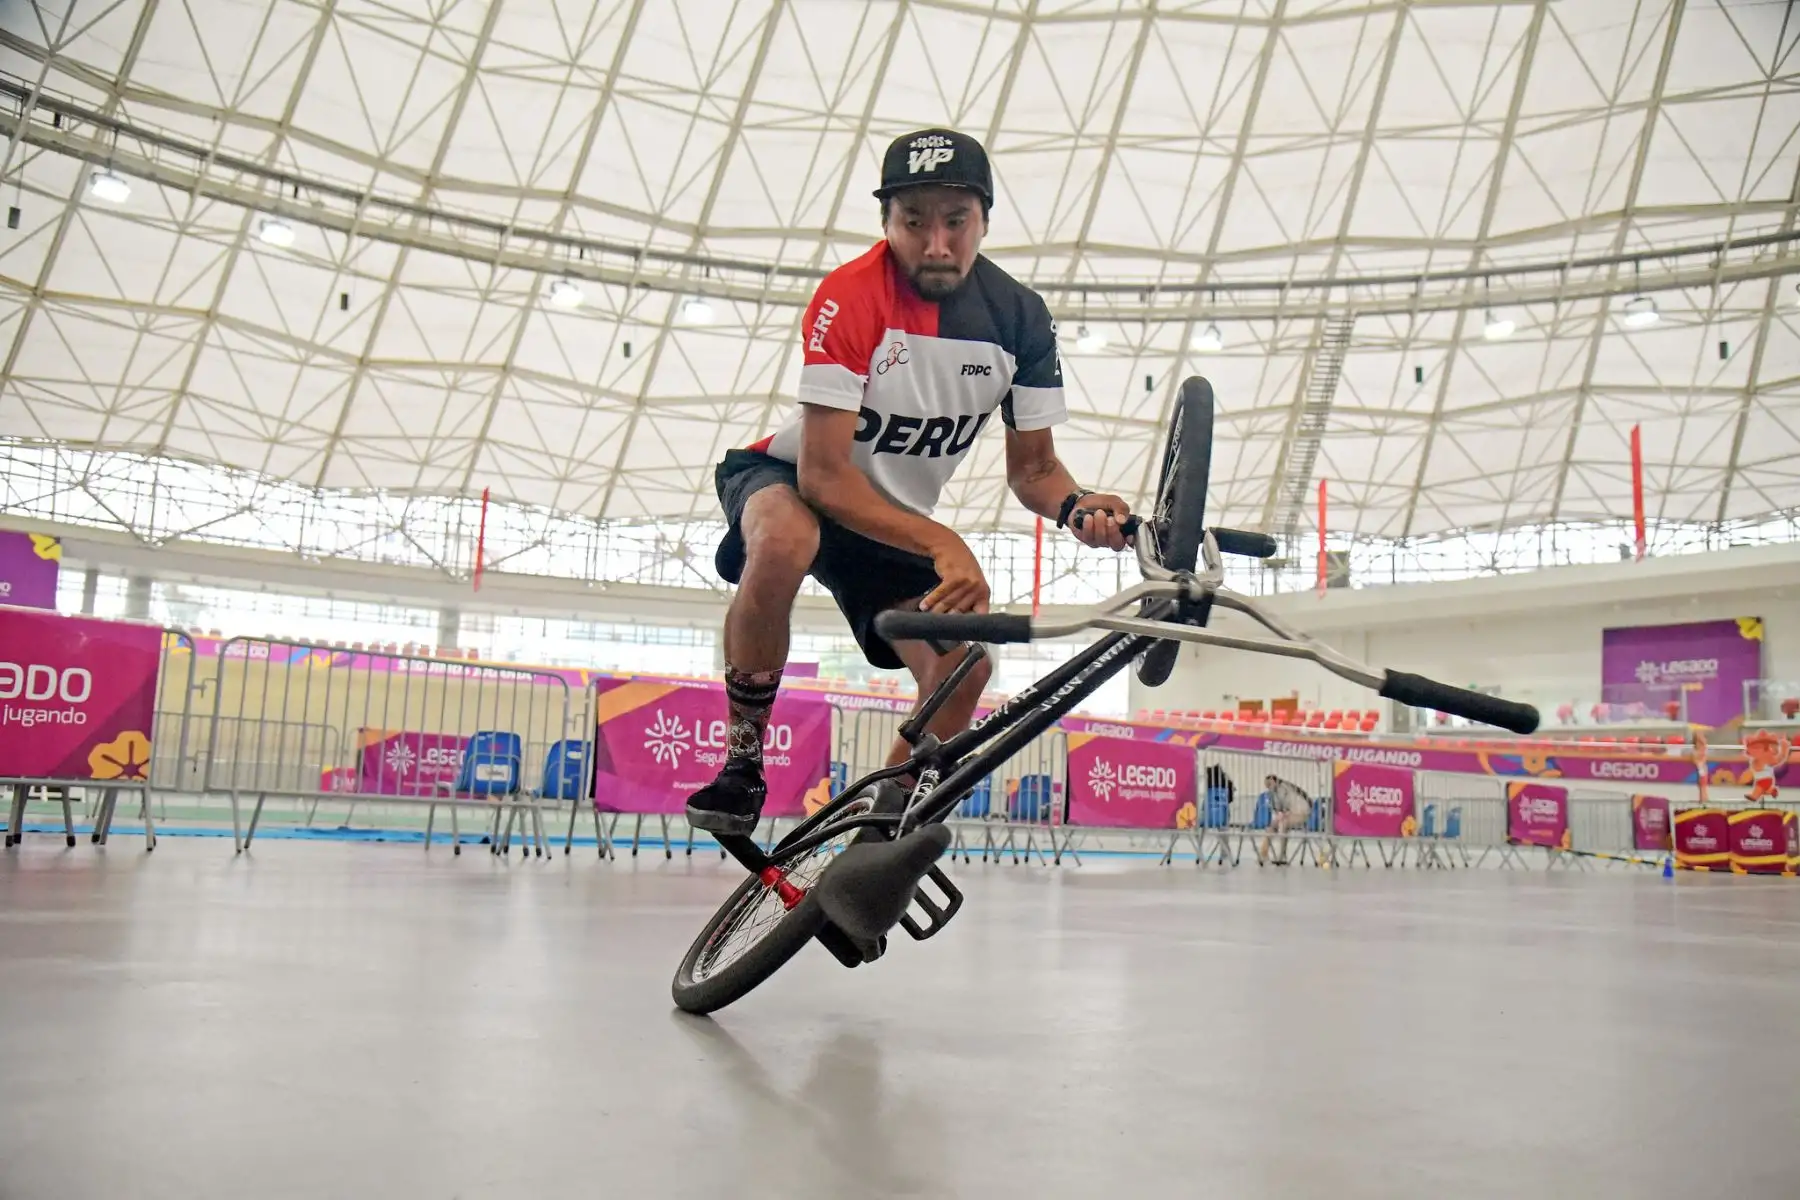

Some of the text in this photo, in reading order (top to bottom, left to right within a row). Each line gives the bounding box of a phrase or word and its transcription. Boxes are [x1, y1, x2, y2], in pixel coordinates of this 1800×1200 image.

[809, 299, 840, 353] PERU
[960, 363, 992, 377] FDPC
[853, 404, 992, 459] PERU
[0, 661, 92, 703] ADO
[3, 703, 87, 727] jugando
[695, 719, 793, 752] LEDO
[1263, 740, 1422, 767] SEGUIMOS JUGANDO
